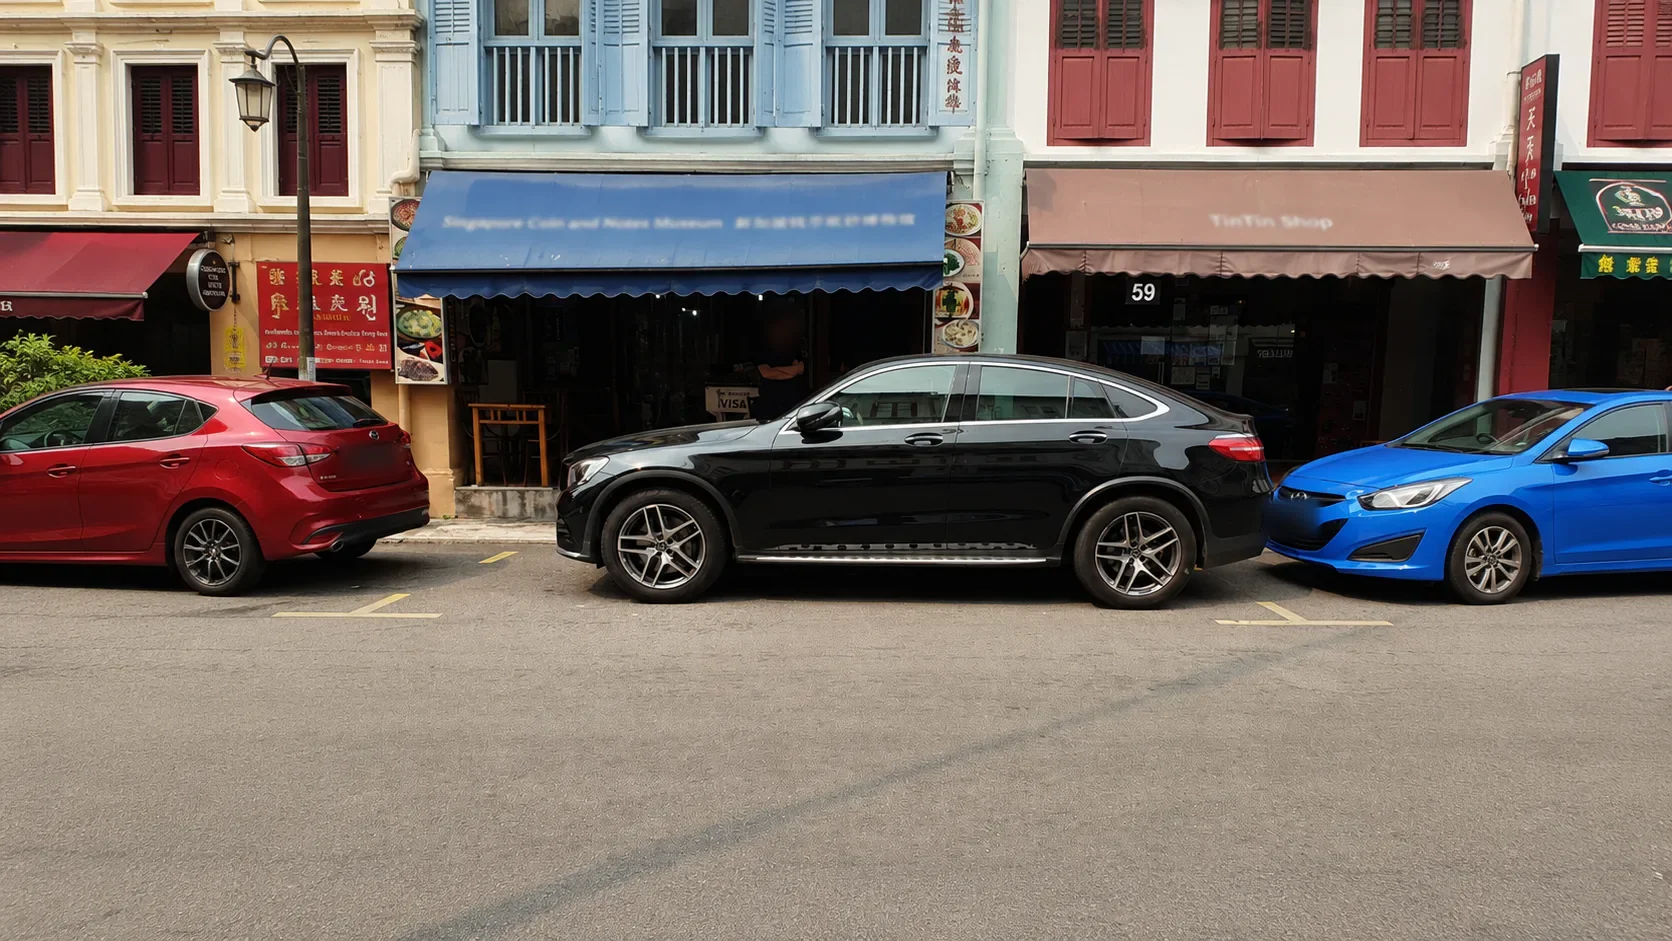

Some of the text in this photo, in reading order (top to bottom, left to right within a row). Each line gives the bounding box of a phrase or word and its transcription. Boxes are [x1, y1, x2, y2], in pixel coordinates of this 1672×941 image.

[1280, 215, 1333, 231] Shop
[1131, 283, 1156, 302] 59
[720, 398, 747, 409] VISA
